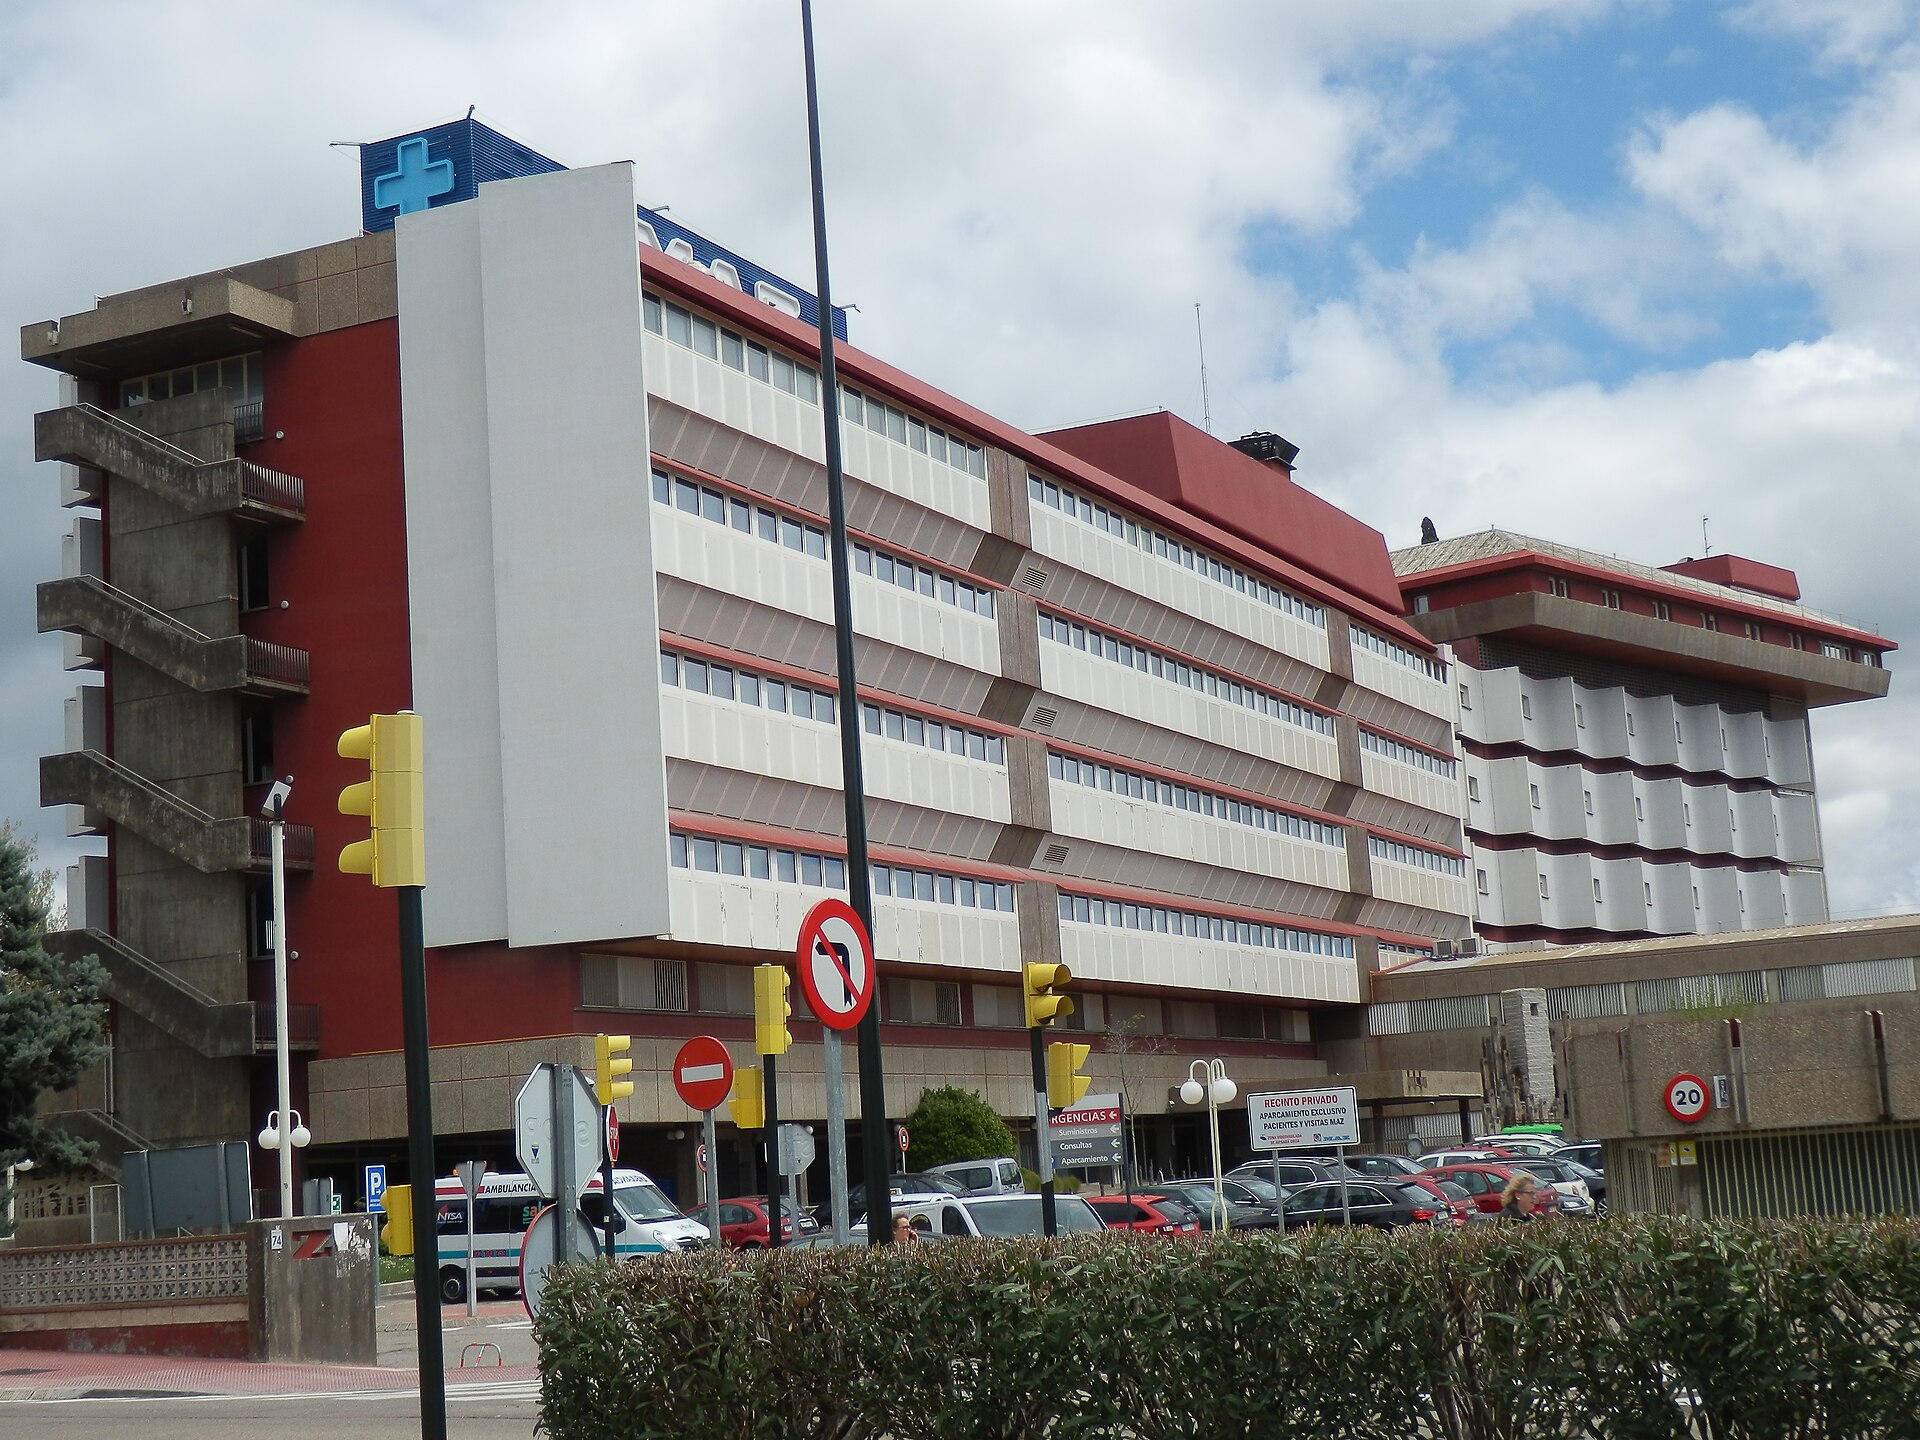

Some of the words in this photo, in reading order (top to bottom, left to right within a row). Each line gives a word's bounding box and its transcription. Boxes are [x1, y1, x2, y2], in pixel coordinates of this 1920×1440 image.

[1264, 1097, 1300, 1108] RECINTO
[1302, 1094, 1338, 1106] PRIVADO
[1675, 1089, 1700, 1105] 20
[1049, 1111, 1106, 1124] RGENCIAS
[1259, 1109, 1310, 1120] APARCAMIENTO
[1311, 1107, 1347, 1117] EXCLUSIVO
[1263, 1120, 1299, 1130] PACIENTES
[1299, 1120, 1304, 1128] Y
[1304, 1118, 1329, 1127] VISITAS
[1330, 1117, 1345, 1125] MAZ
[1058, 1127, 1098, 1136] Suministros
[1059, 1141, 1093, 1150] Consultas
[1061, 1155, 1109, 1166] Aparcamiento
[370, 1172, 382, 1196] P
[484, 1183, 536, 1194] AMBULANCIA
[272, 1235, 282, 1246] 74
